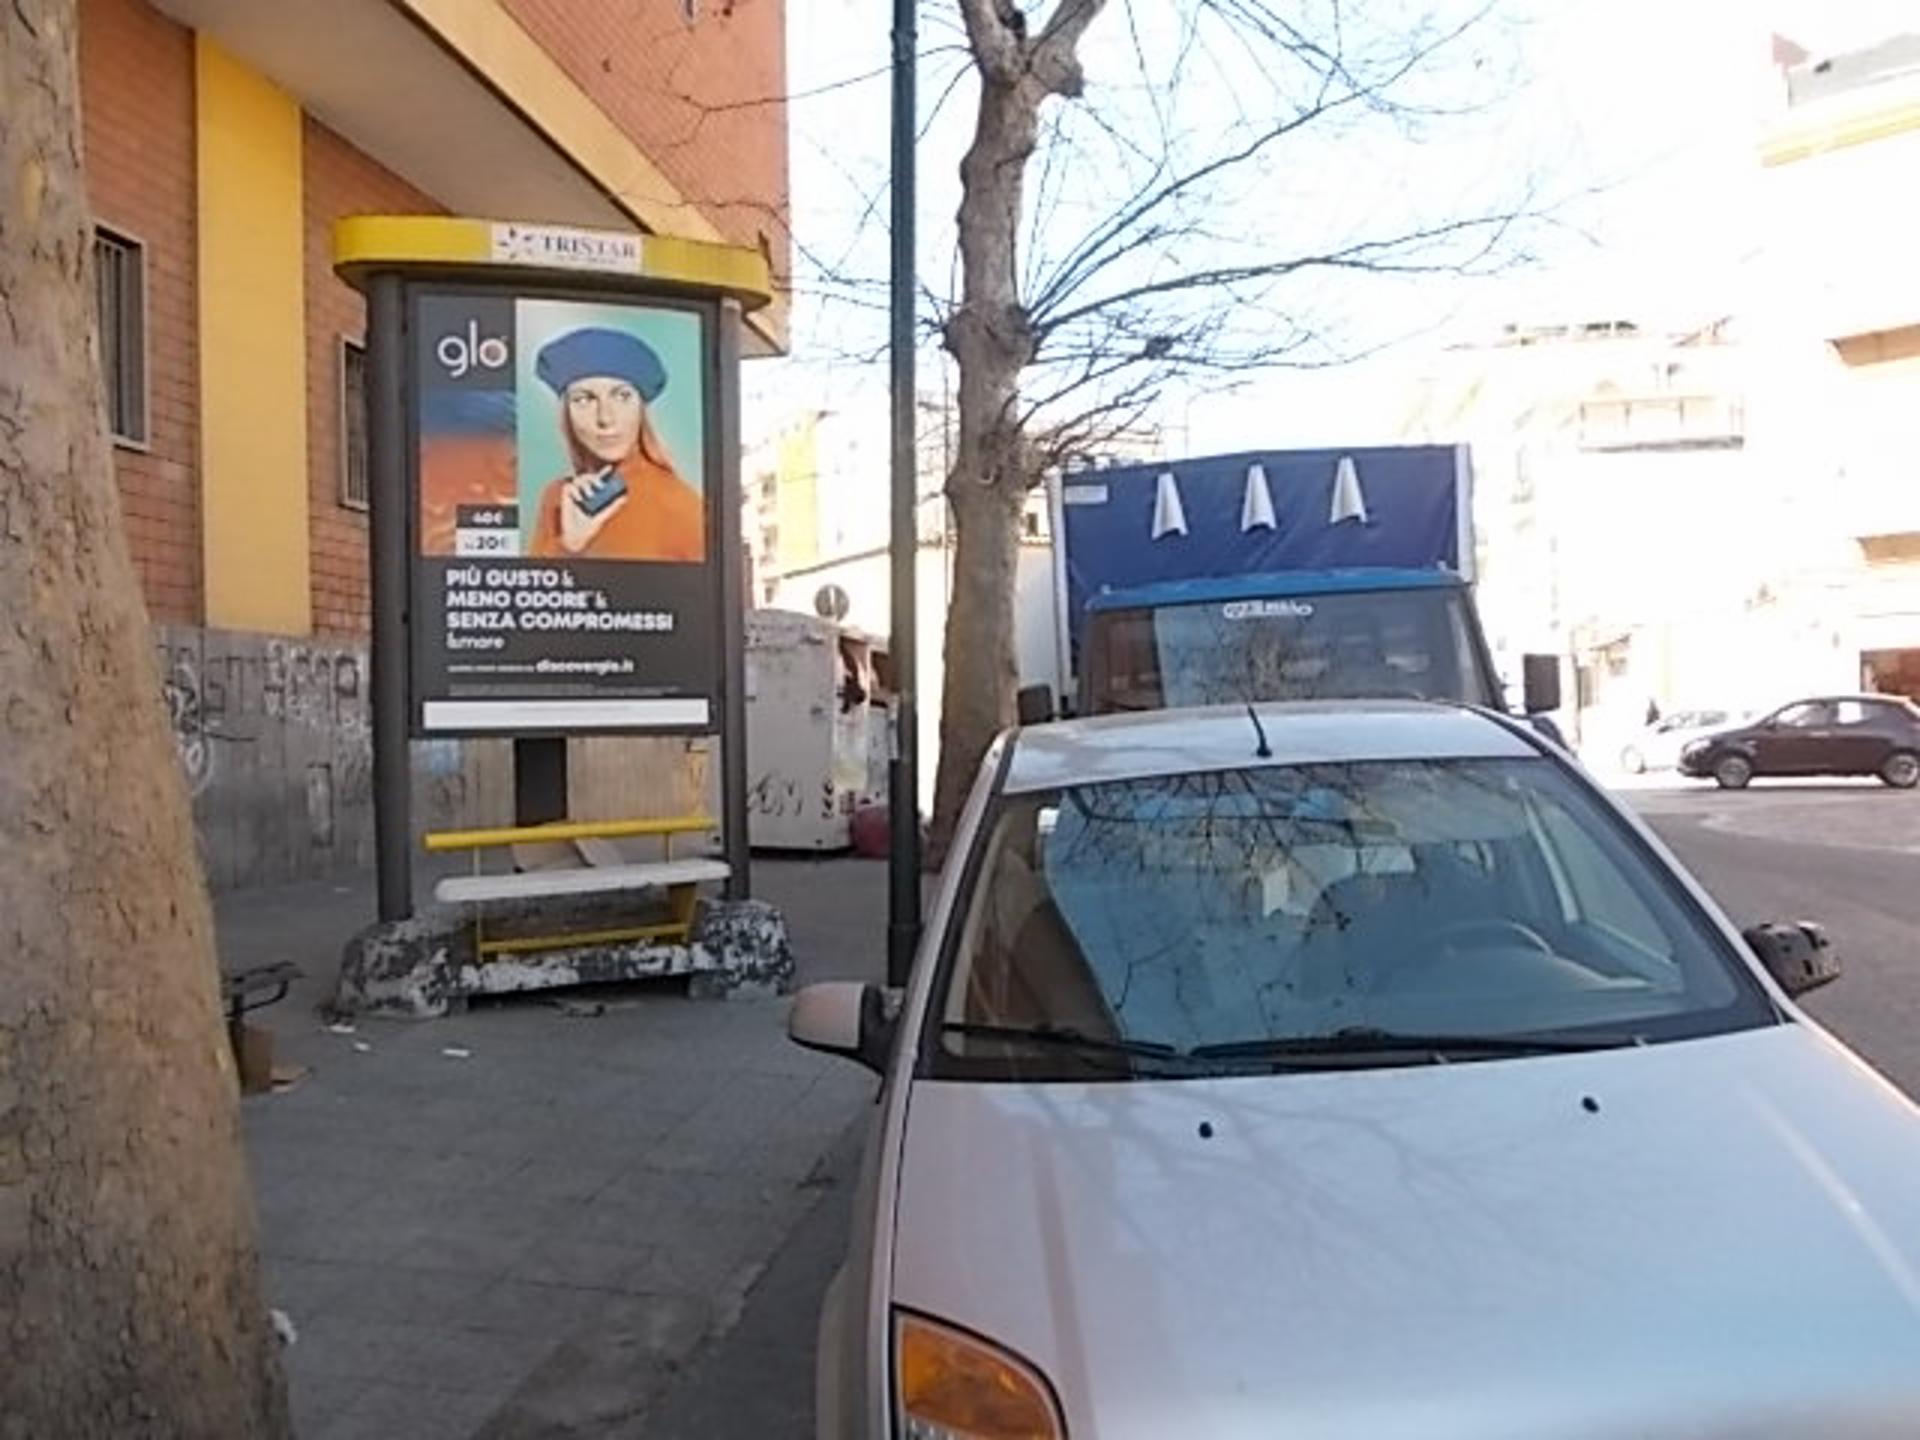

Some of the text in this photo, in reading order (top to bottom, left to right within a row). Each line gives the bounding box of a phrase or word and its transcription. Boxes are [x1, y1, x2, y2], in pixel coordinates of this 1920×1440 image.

[543, 235, 635, 258] TRISTAR
[438, 320, 508, 378] glo
[446, 565, 481, 587] PIÙ
[486, 570, 558, 587] GUSTO
[446, 591, 511, 608] MENO
[446, 612, 674, 632] SENZA COMPROMESSI
